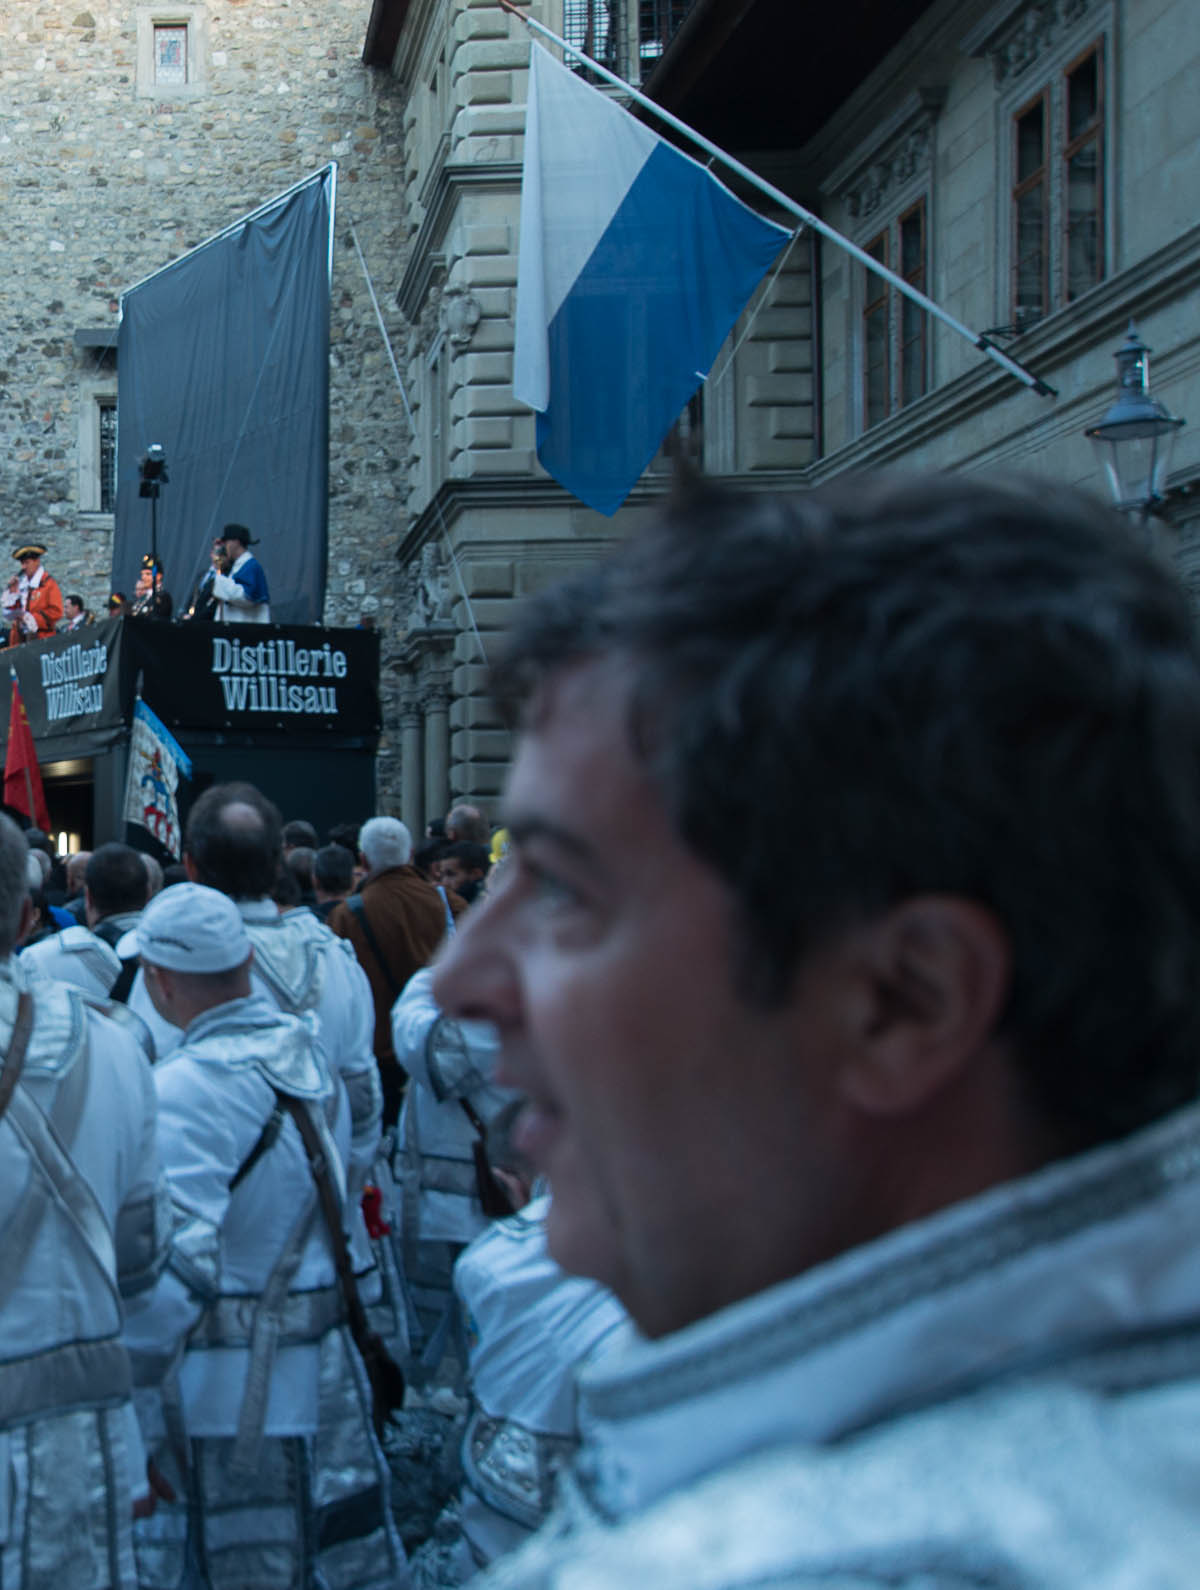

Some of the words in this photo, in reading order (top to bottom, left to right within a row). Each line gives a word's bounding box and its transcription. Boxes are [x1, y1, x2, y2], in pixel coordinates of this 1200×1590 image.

[40, 640, 107, 687] Distillerie
[211, 638, 347, 677] Distillerie
[46, 682, 103, 720] Willisau
[219, 676, 338, 713] Willisau
